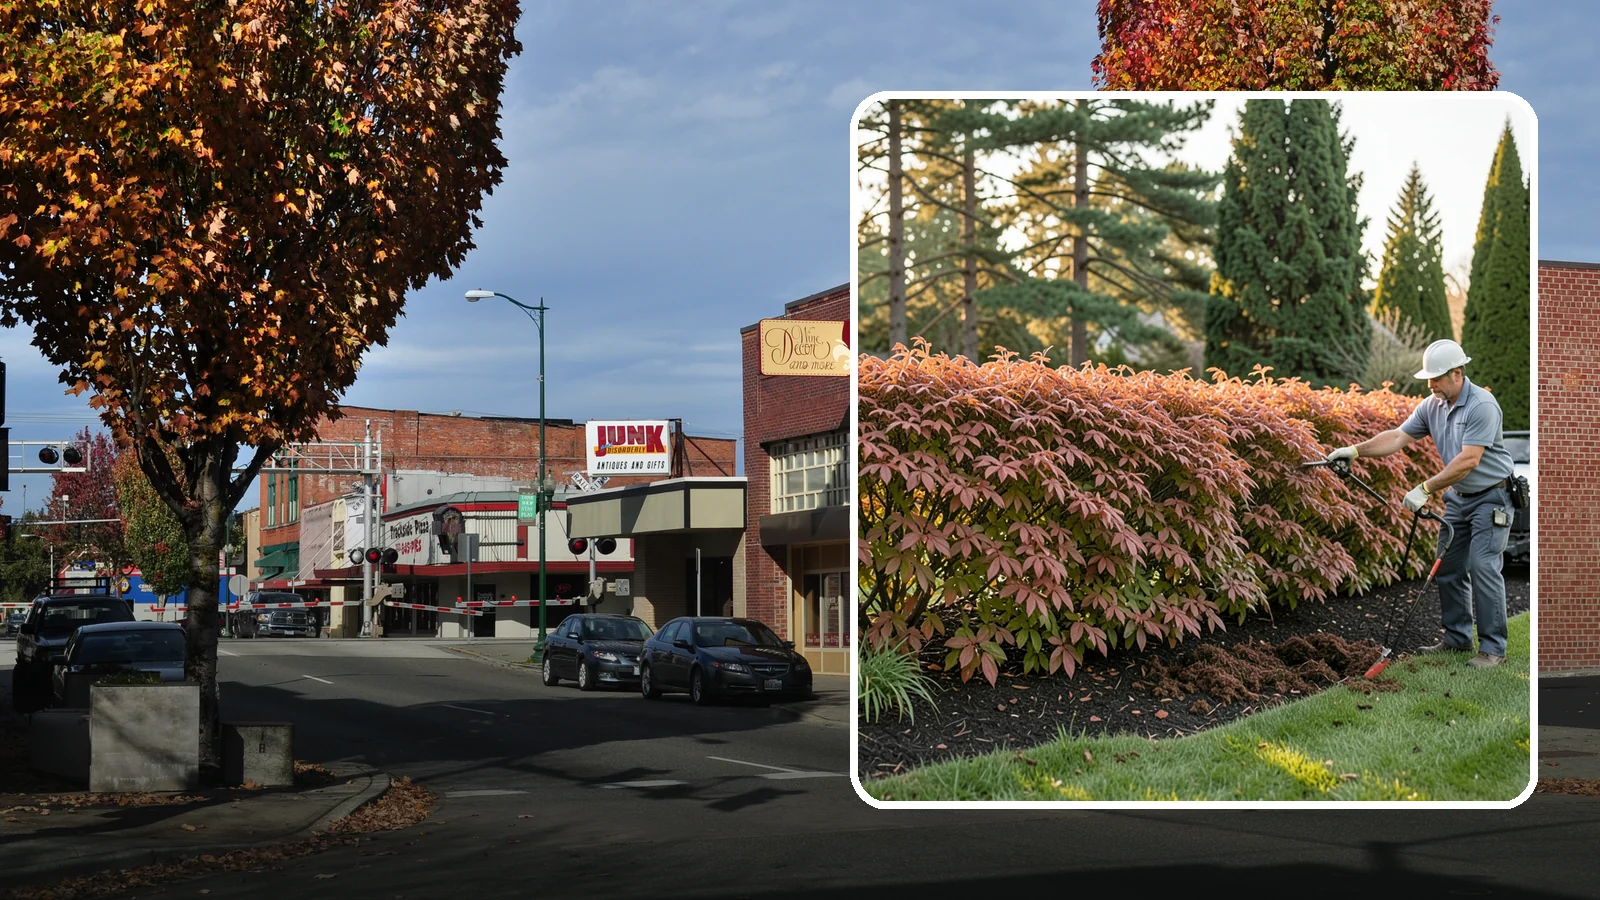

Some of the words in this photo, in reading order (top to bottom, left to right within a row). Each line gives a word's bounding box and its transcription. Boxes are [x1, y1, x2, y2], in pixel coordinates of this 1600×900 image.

[595, 425, 665, 457] JUNK
[607, 446, 646, 454] DISORDERLY
[597, 461, 628, 470] ANTIQUES
[631, 461, 644, 470] AND
[647, 460, 665, 469] GIFTS
[390, 521, 413, 539] Trackside
[414, 519, 429, 535] Pizza
